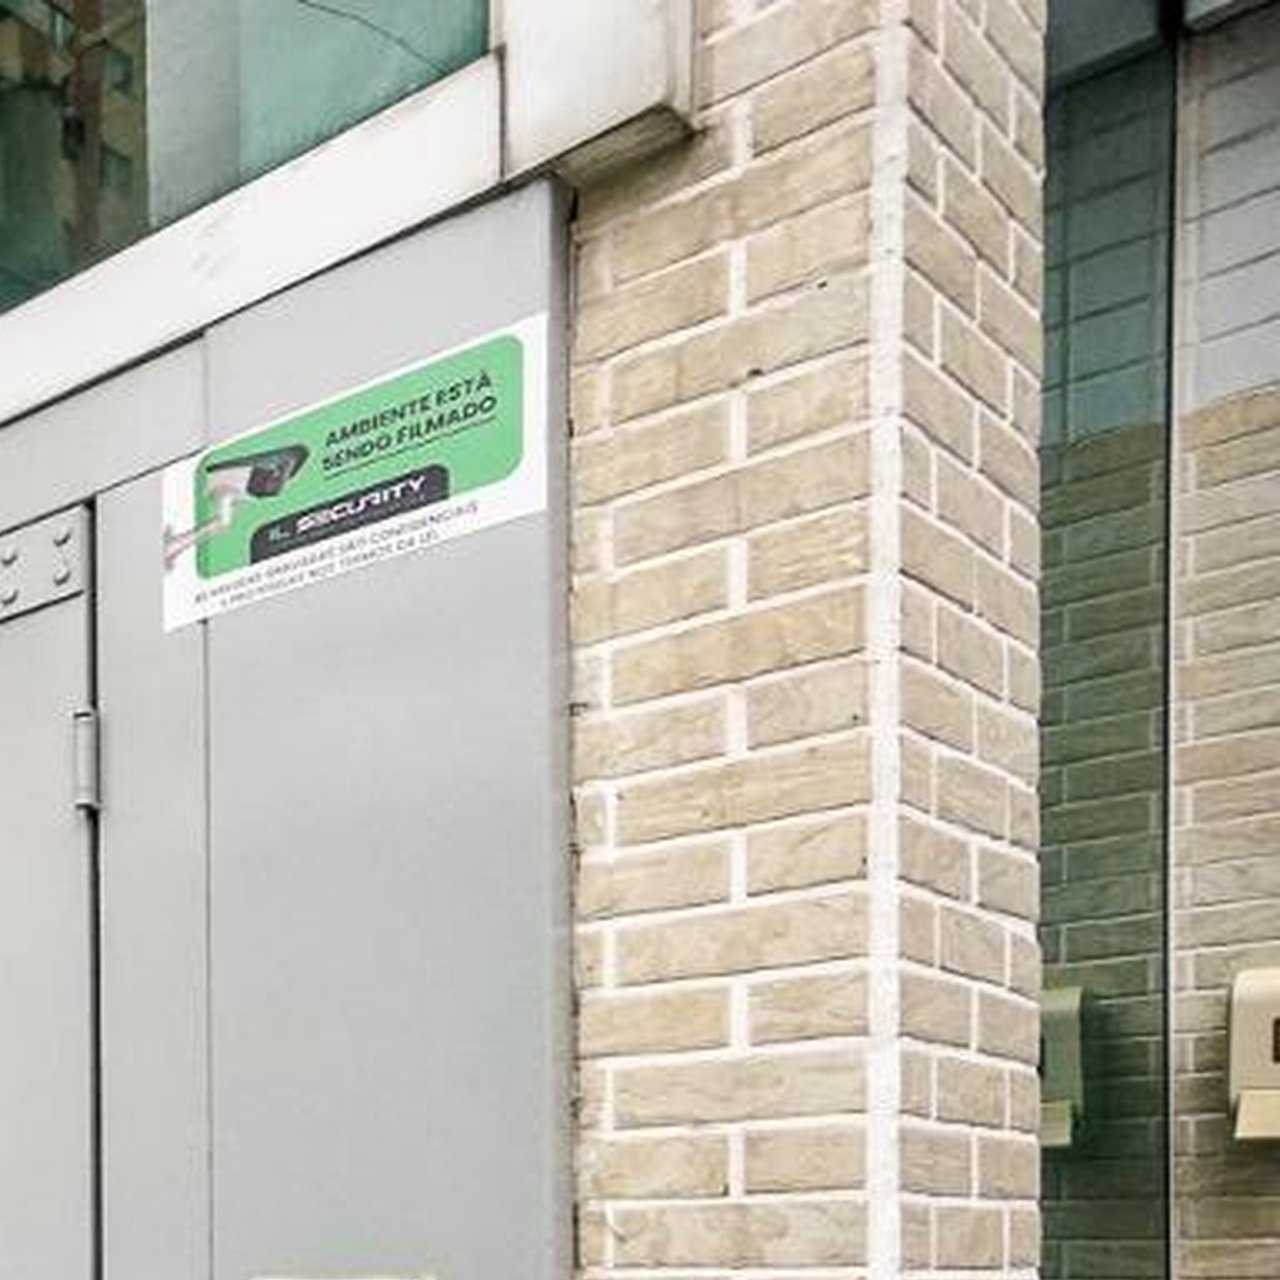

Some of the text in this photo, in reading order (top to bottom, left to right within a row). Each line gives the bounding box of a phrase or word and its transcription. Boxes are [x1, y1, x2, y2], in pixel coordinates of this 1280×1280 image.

[321, 395, 498, 471] SENDO FILMADO
[325, 393, 432, 447] AMBIENTE
[295, 475, 426, 534] SECURITY
